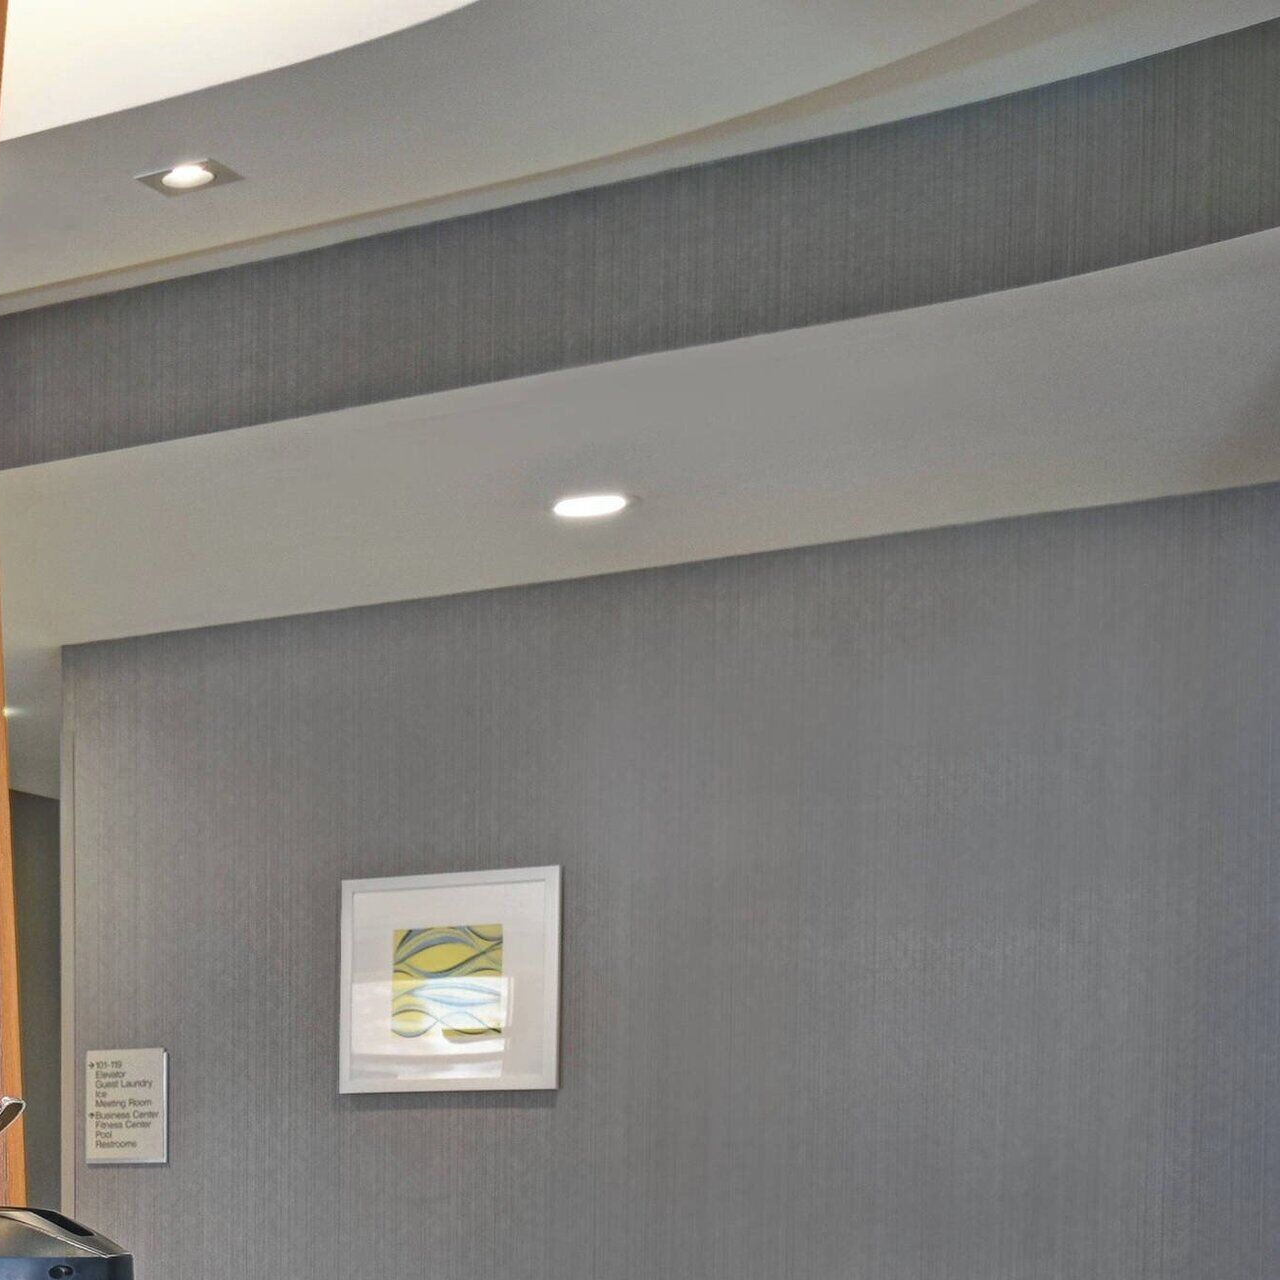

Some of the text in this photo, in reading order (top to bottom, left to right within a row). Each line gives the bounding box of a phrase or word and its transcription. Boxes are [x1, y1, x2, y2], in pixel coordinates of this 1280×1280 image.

[96, 1071, 126, 1079] Elevator
[95, 1080, 153, 1089] Guest Laundry
[96, 1090, 107, 1098] Ice
[95, 1099, 152, 1109] Meeting Room
[95, 1110, 159, 1120] Business Center
[96, 1120, 151, 1129] Fitness Center
[96, 1140, 137, 1149] Restrooms
